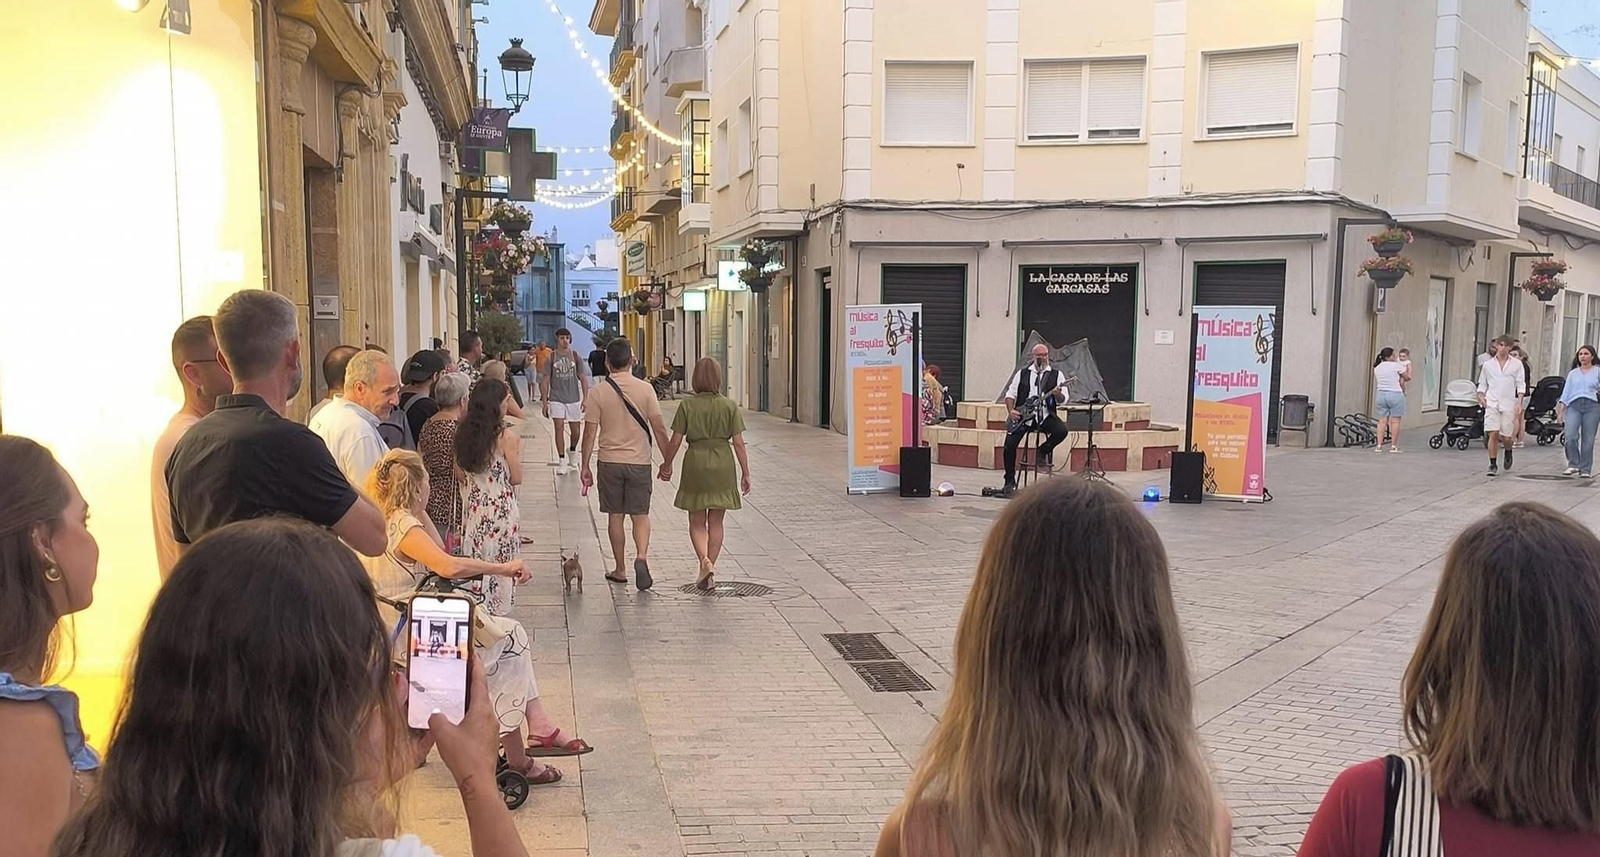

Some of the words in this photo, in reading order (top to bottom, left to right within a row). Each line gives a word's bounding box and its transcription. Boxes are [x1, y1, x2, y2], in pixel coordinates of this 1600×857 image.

[1029, 273, 1046, 283] LA
[1050, 273, 1081, 283] CASA
[1084, 273, 1101, 283] DE
[1105, 273, 1129, 283] LAS
[1046, 284, 1110, 294] CARCASAS
[1197, 313, 1252, 337] música
